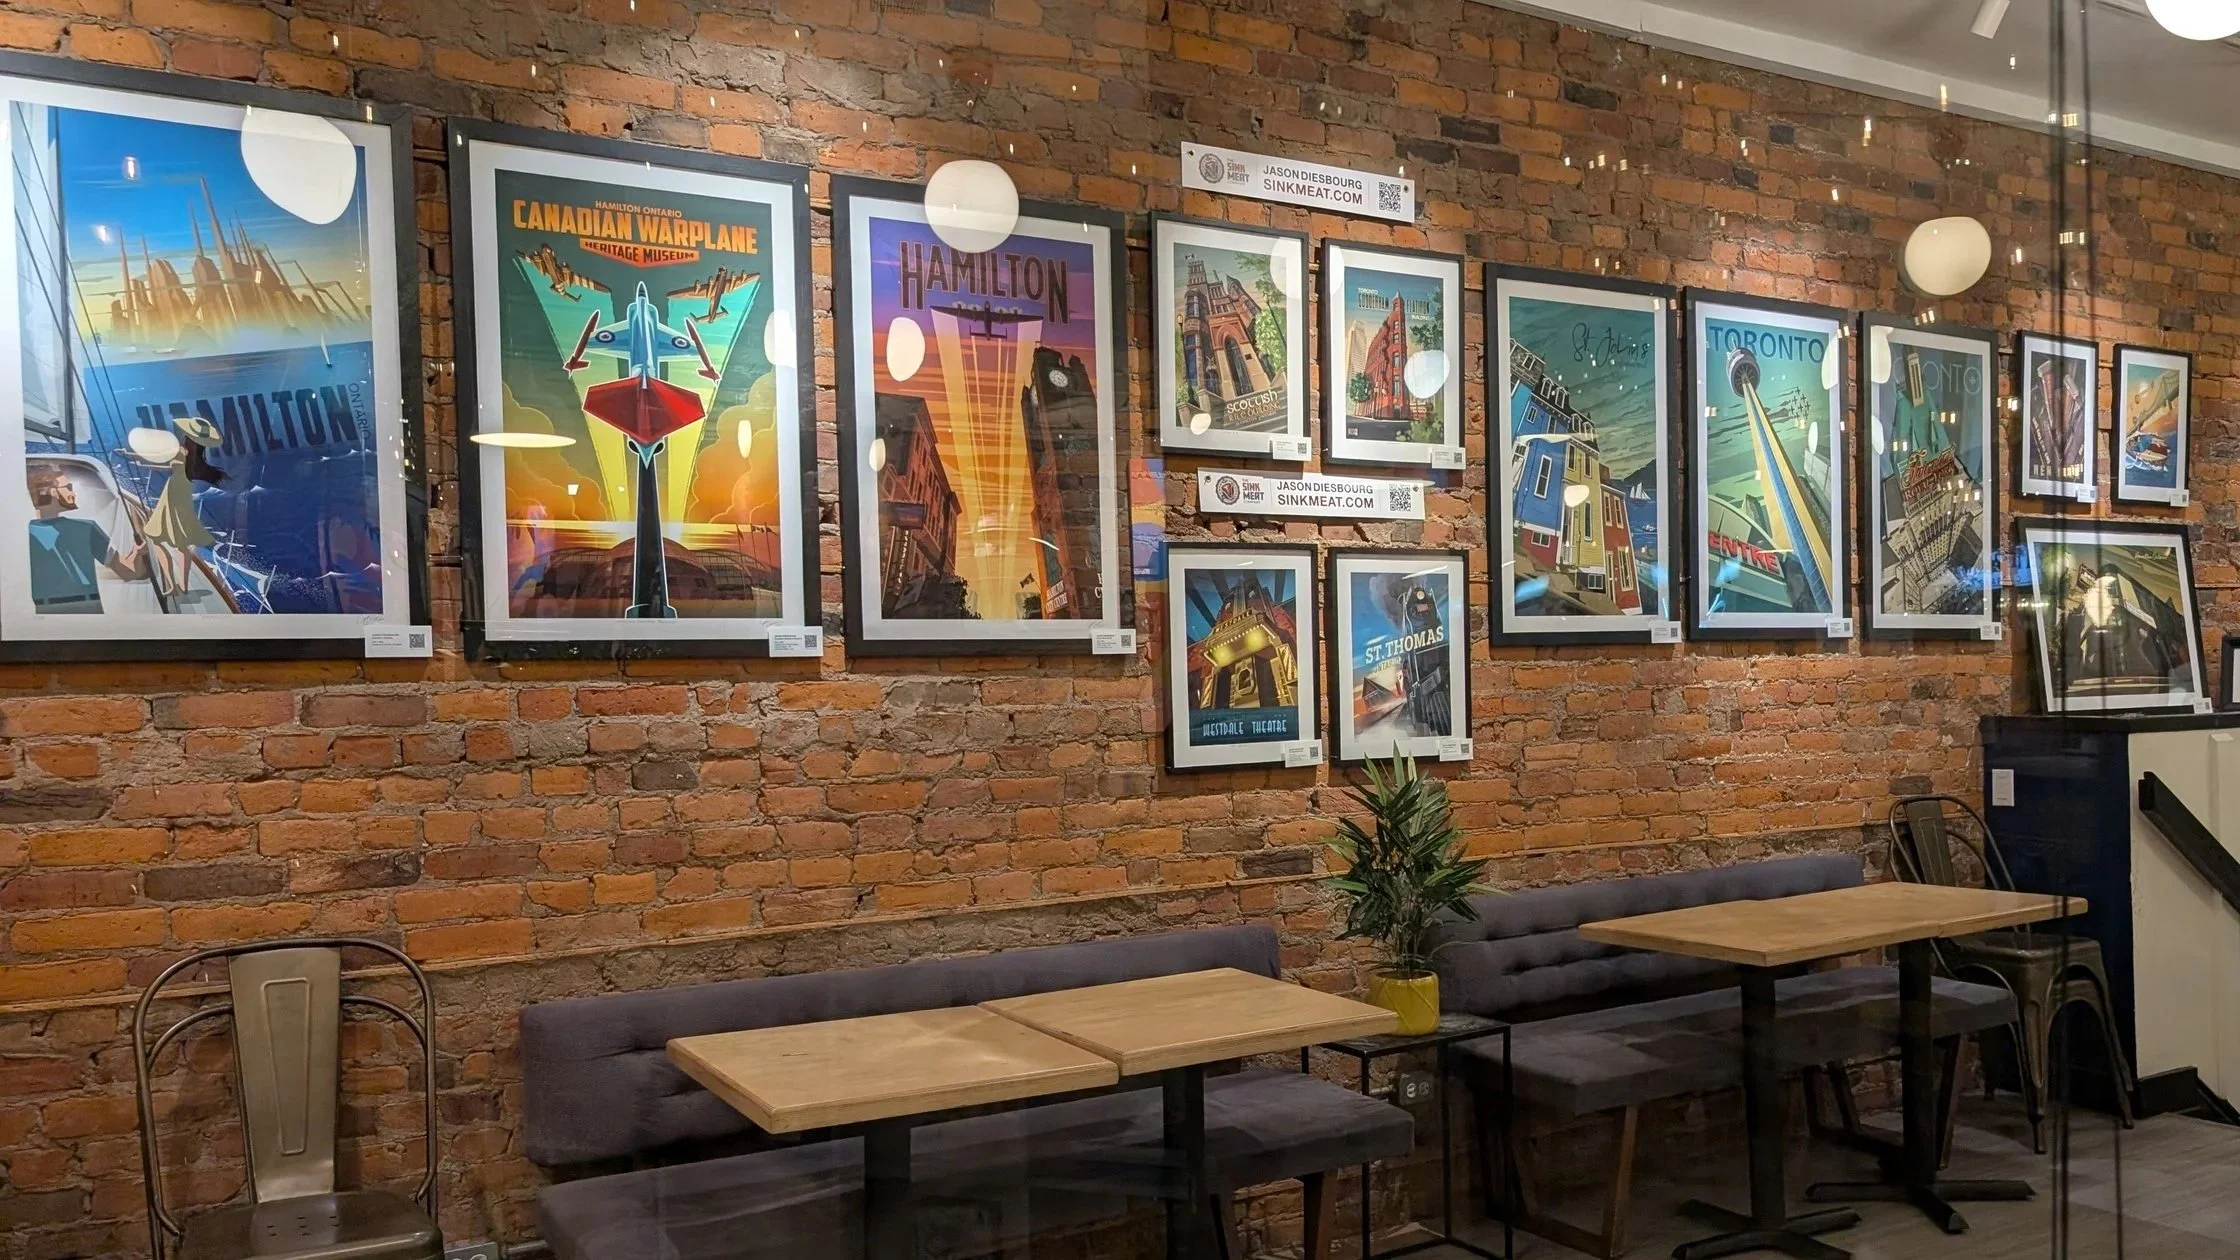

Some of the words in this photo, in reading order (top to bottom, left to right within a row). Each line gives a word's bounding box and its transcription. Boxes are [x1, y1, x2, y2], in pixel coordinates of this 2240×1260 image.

[1263, 164, 1300, 181] JASON
[1300, 168, 1363, 190] DIESBOURG
[1263, 178, 1363, 205] SINKMEAT.COM
[595, 200, 641, 214] HAMILTON
[642, 206, 683, 218] ONTARIO
[513, 198, 633, 240] CANADIAN
[636, 213, 758, 255] WARPLANE
[584, 241, 639, 263] HERITAGE
[643, 247, 695, 263] MUSEUM
[899, 240, 1069, 325] HAMILTON
[1709, 326, 1825, 363] TORONTO
[348, 382, 371, 441] ONTARIO
[1242, 482, 1260, 491] SINK
[1243, 491, 1264, 501] MEAT
[1277, 481, 1312, 492] JASON
[1313, 482, 1373, 494] DIESBOURG
[1277, 494, 1374, 509] SINKMEAT.COM
[1203, 721, 1244, 737] WESTDALE
[1251, 719, 1287, 734] THEATRE
